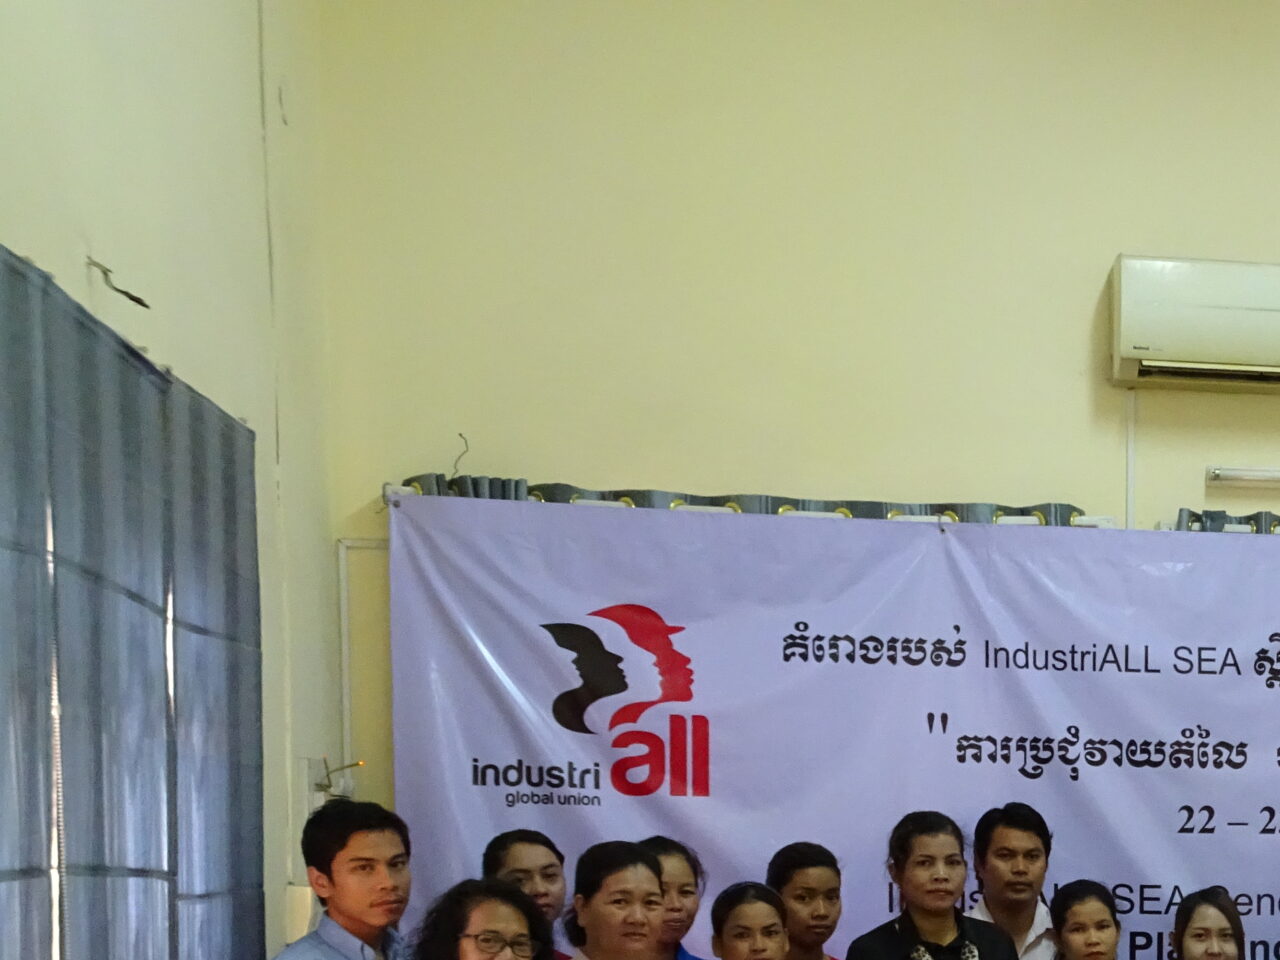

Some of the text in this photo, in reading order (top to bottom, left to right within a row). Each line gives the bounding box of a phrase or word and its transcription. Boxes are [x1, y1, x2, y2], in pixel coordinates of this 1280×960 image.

[985, 640, 1161, 673] IndustriALL
[1173, 645, 1242, 675] SEA
[472, 713, 710, 797] industri all
[505, 791, 601, 807] global union
[1177, 804, 1216, 834] 22
